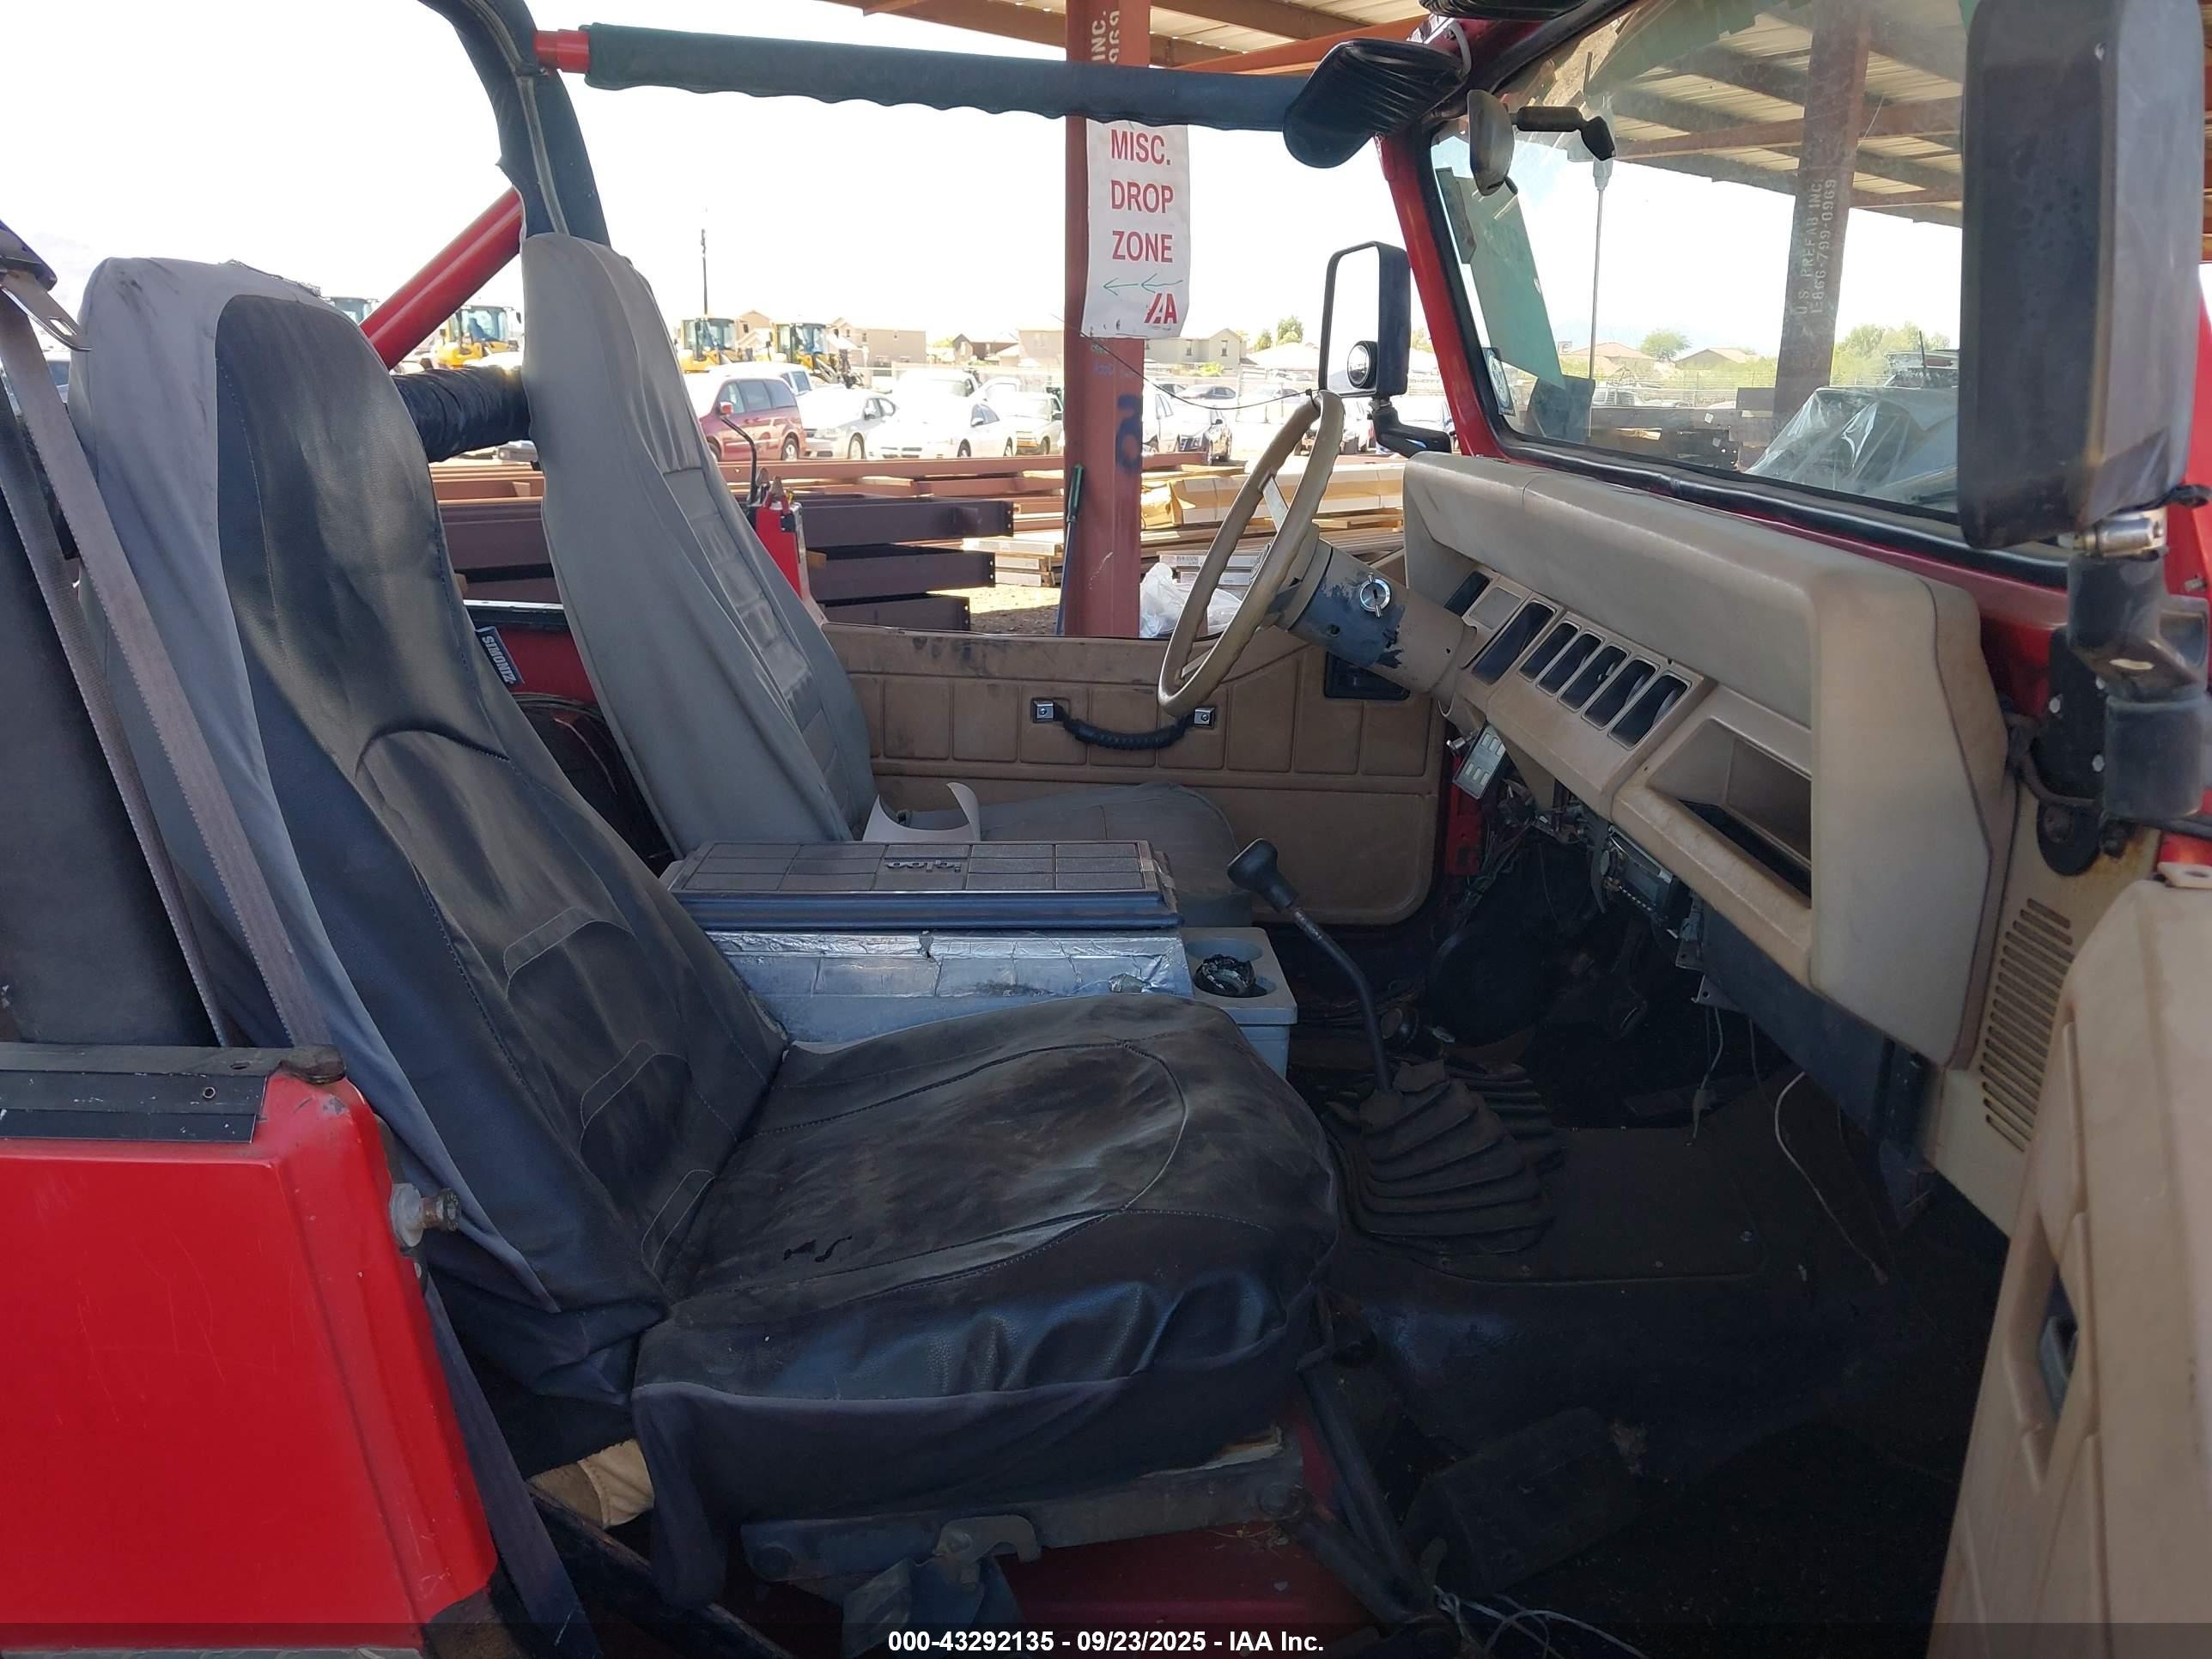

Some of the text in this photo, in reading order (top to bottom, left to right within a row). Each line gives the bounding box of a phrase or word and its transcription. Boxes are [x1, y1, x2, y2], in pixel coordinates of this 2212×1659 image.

[1091, 10, 1107, 61] INC.
[1110, 129, 1171, 166] MISC.
[1110, 179, 1174, 214] DROP
[1111, 230, 1174, 263] ZONE
[1800, 216, 1820, 278] PREFAB
[482, 635, 517, 684] SIMONIZ
